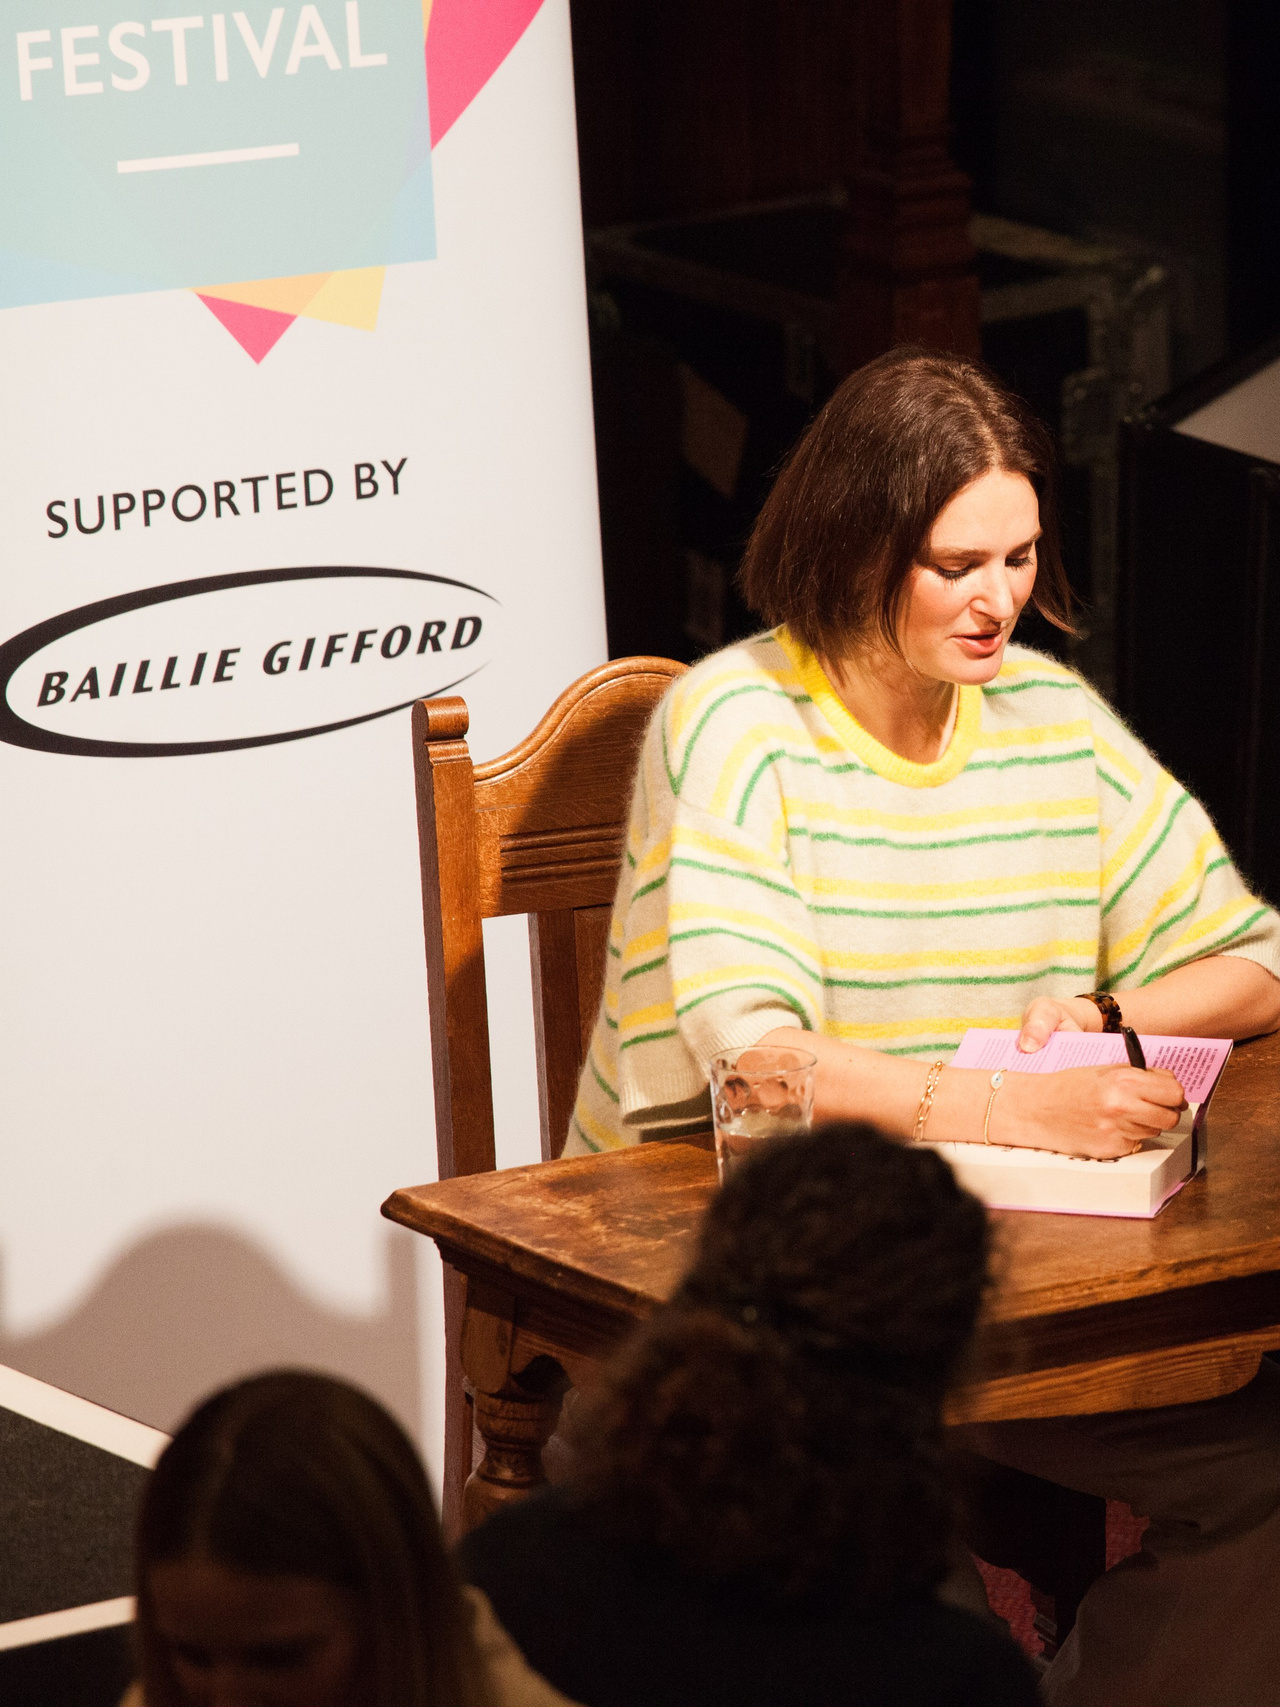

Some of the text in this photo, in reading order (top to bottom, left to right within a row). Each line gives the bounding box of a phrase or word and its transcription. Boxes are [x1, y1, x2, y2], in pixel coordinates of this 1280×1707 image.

[16, 0, 388, 101] FESTIVAL
[46, 457, 408, 539] SUPPORTED BY
[37, 616, 483, 707] BAILLIE GIFFORD
